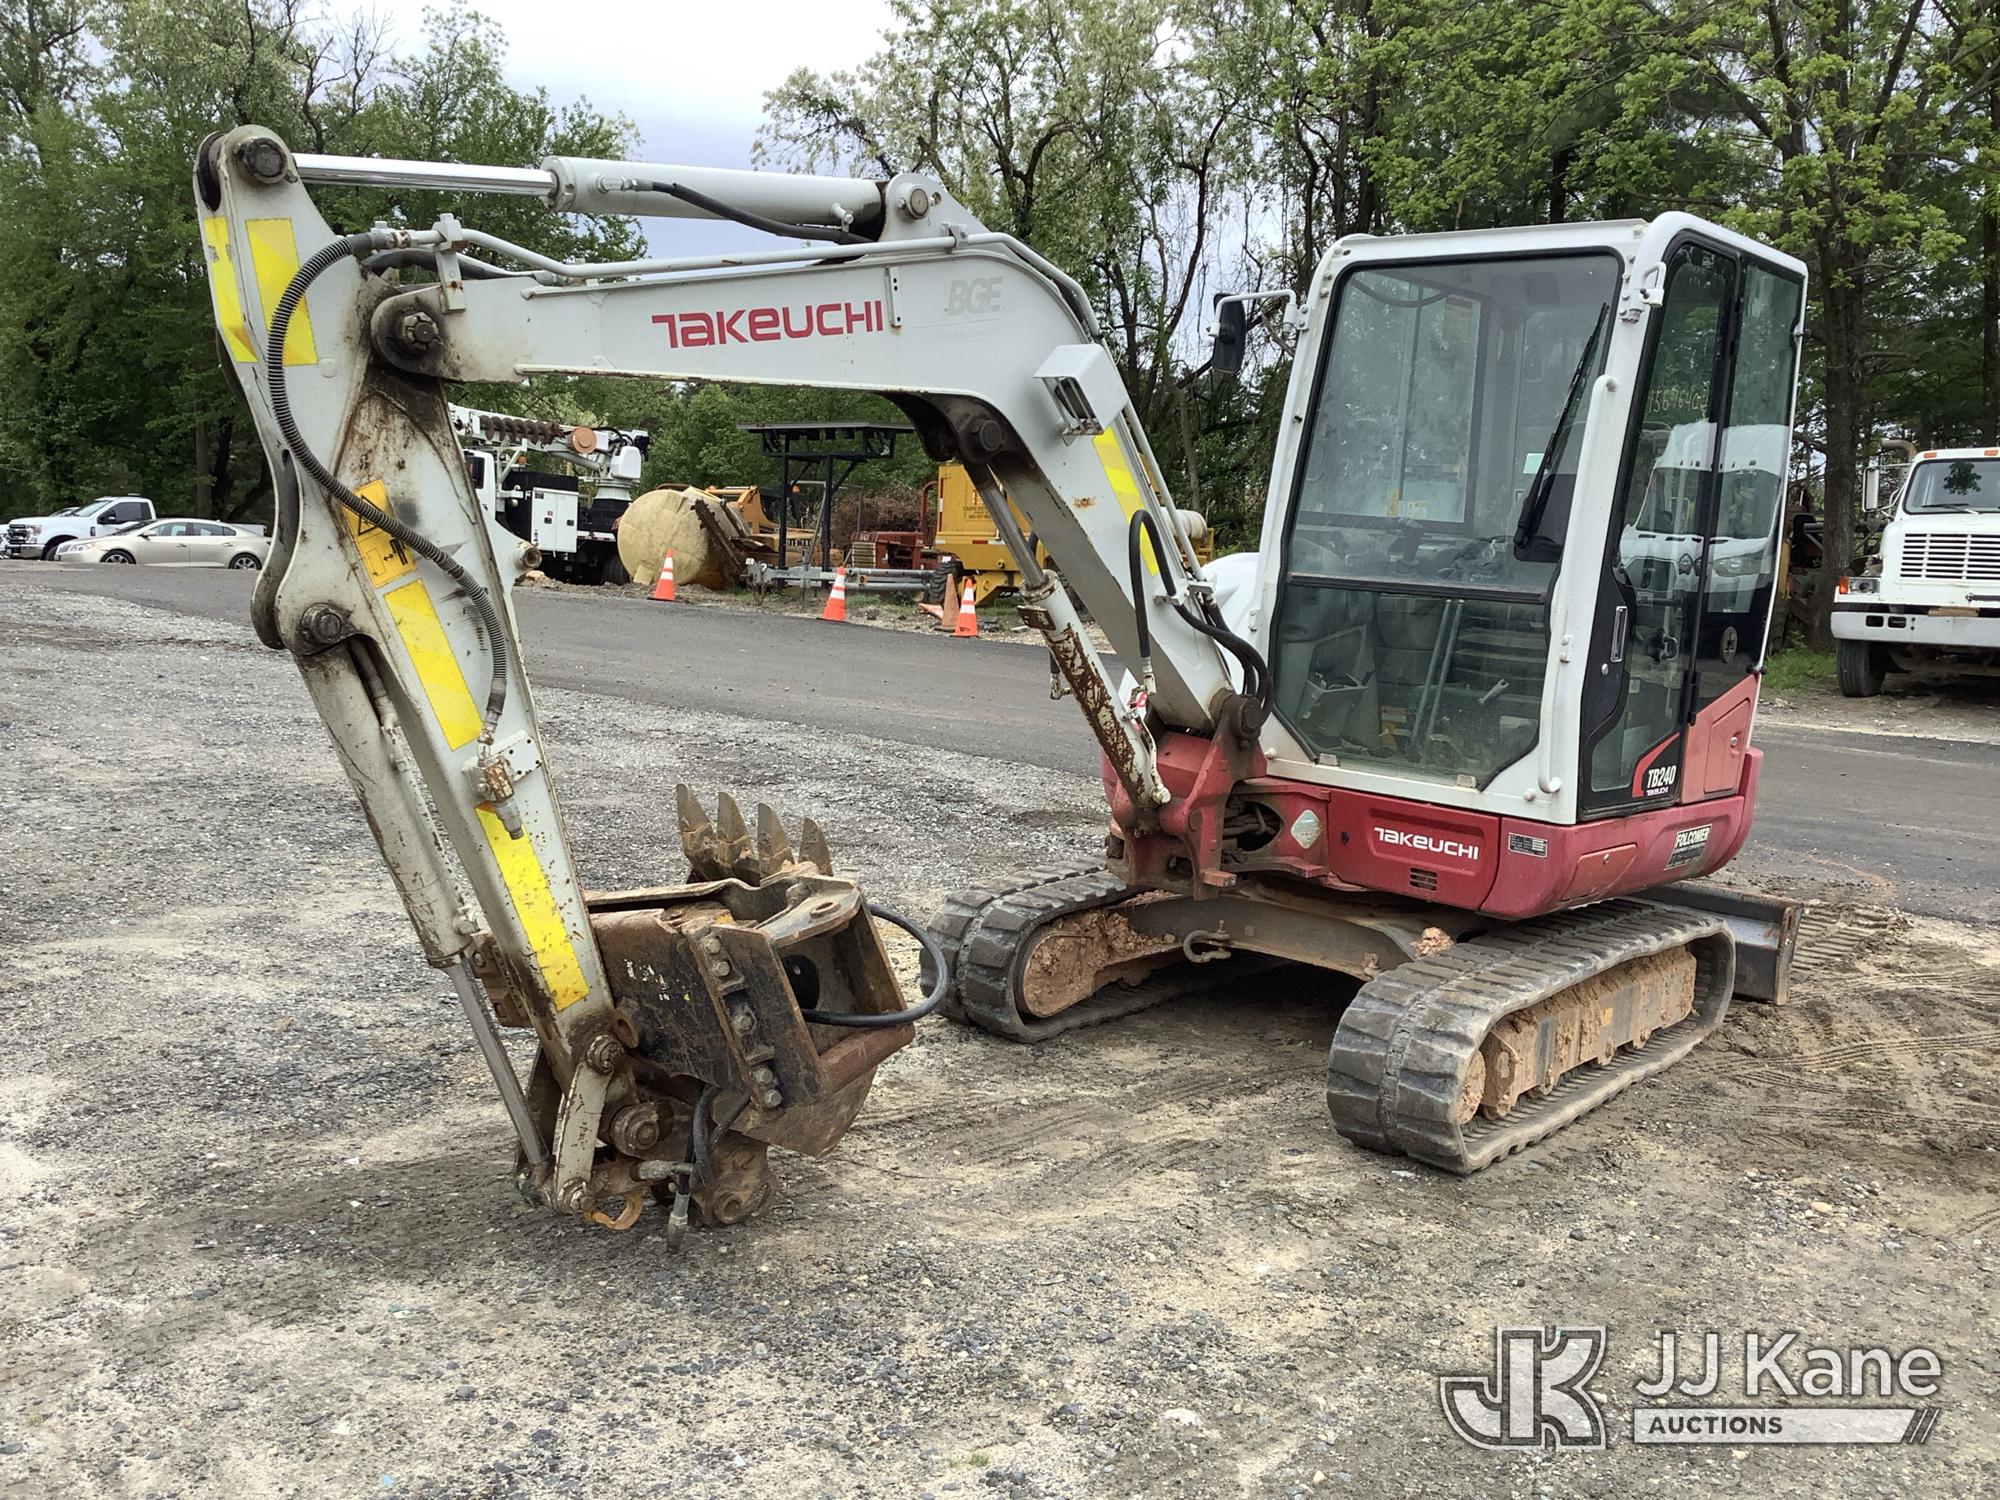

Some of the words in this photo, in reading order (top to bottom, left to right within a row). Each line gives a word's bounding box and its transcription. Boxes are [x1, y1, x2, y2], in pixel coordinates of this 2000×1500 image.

[947, 276, 1003, 317] BGE
[651, 300, 884, 349] TAKEUCHI
[1647, 765, 1677, 788] TB240
[1374, 827, 1479, 860] TAKEUCHI
